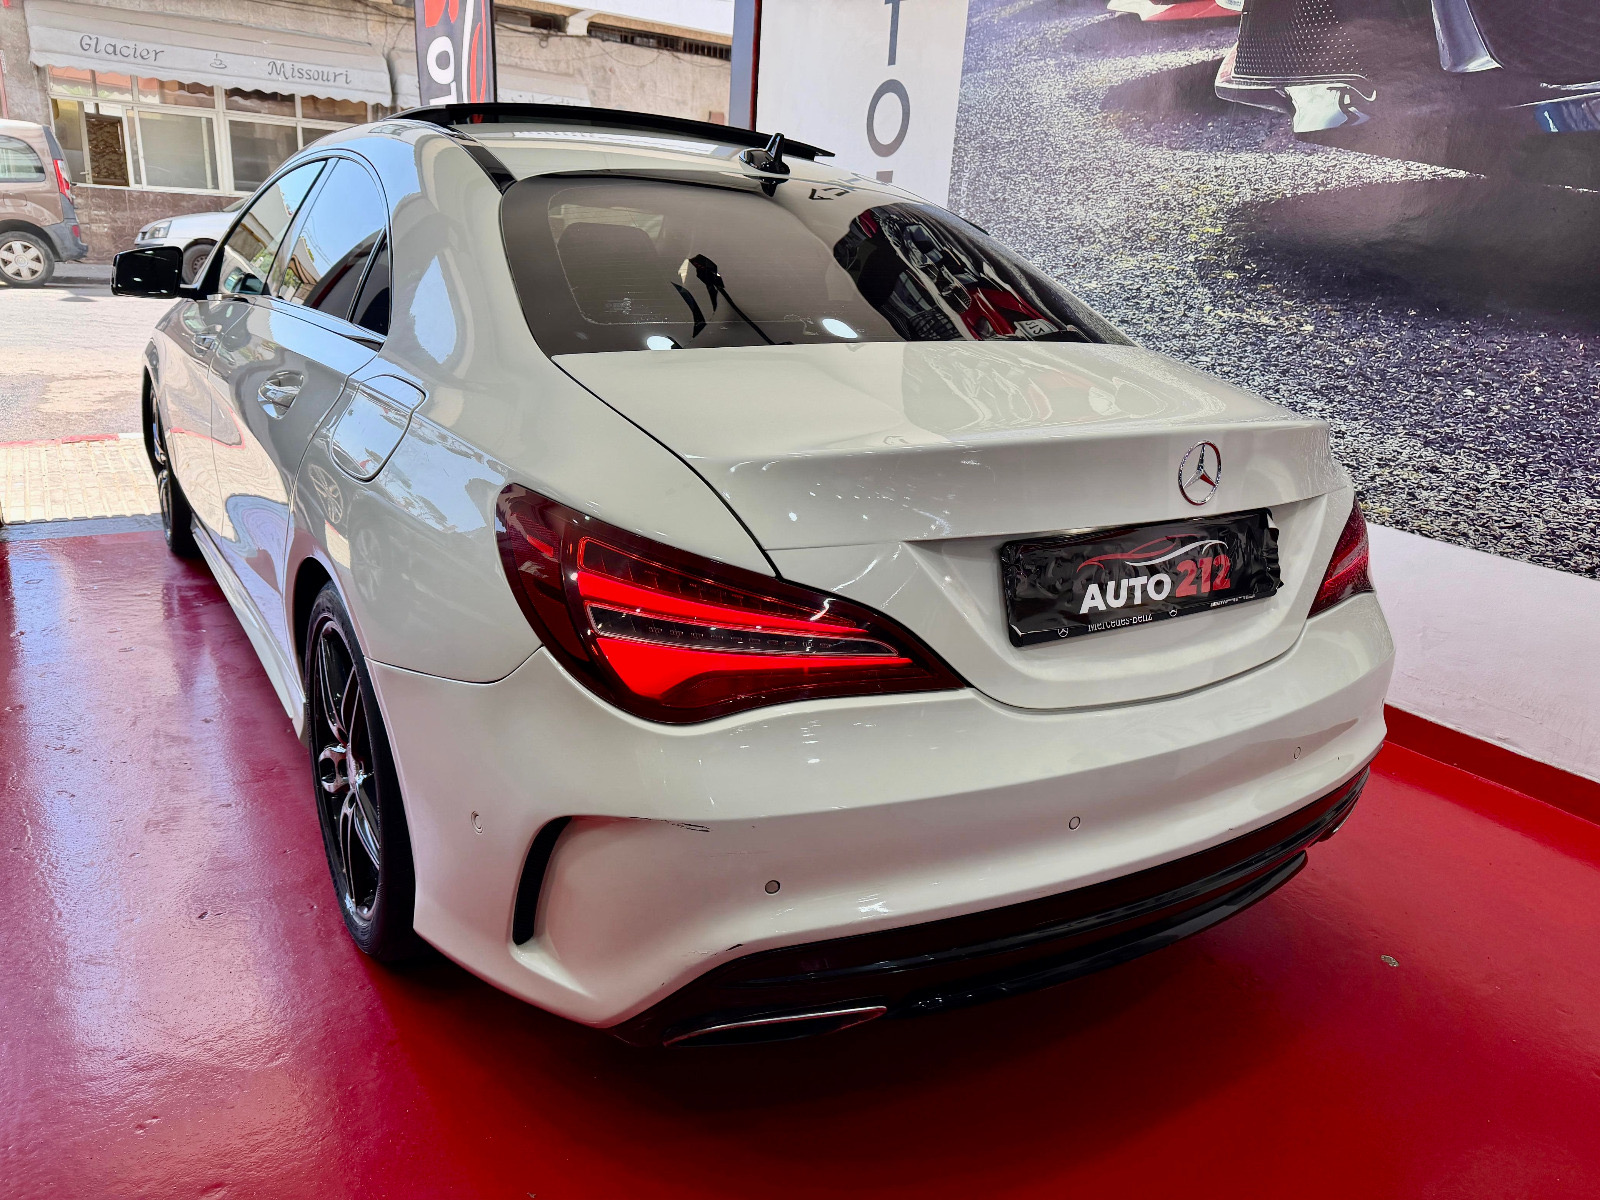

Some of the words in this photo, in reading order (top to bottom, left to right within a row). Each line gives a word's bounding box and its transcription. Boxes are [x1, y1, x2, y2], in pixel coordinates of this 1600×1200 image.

[79, 34, 164, 62] Glacier
[267, 60, 353, 85] Missouri
[1080, 573, 1172, 614] AUTO
[1175, 554, 1231, 598] 212
